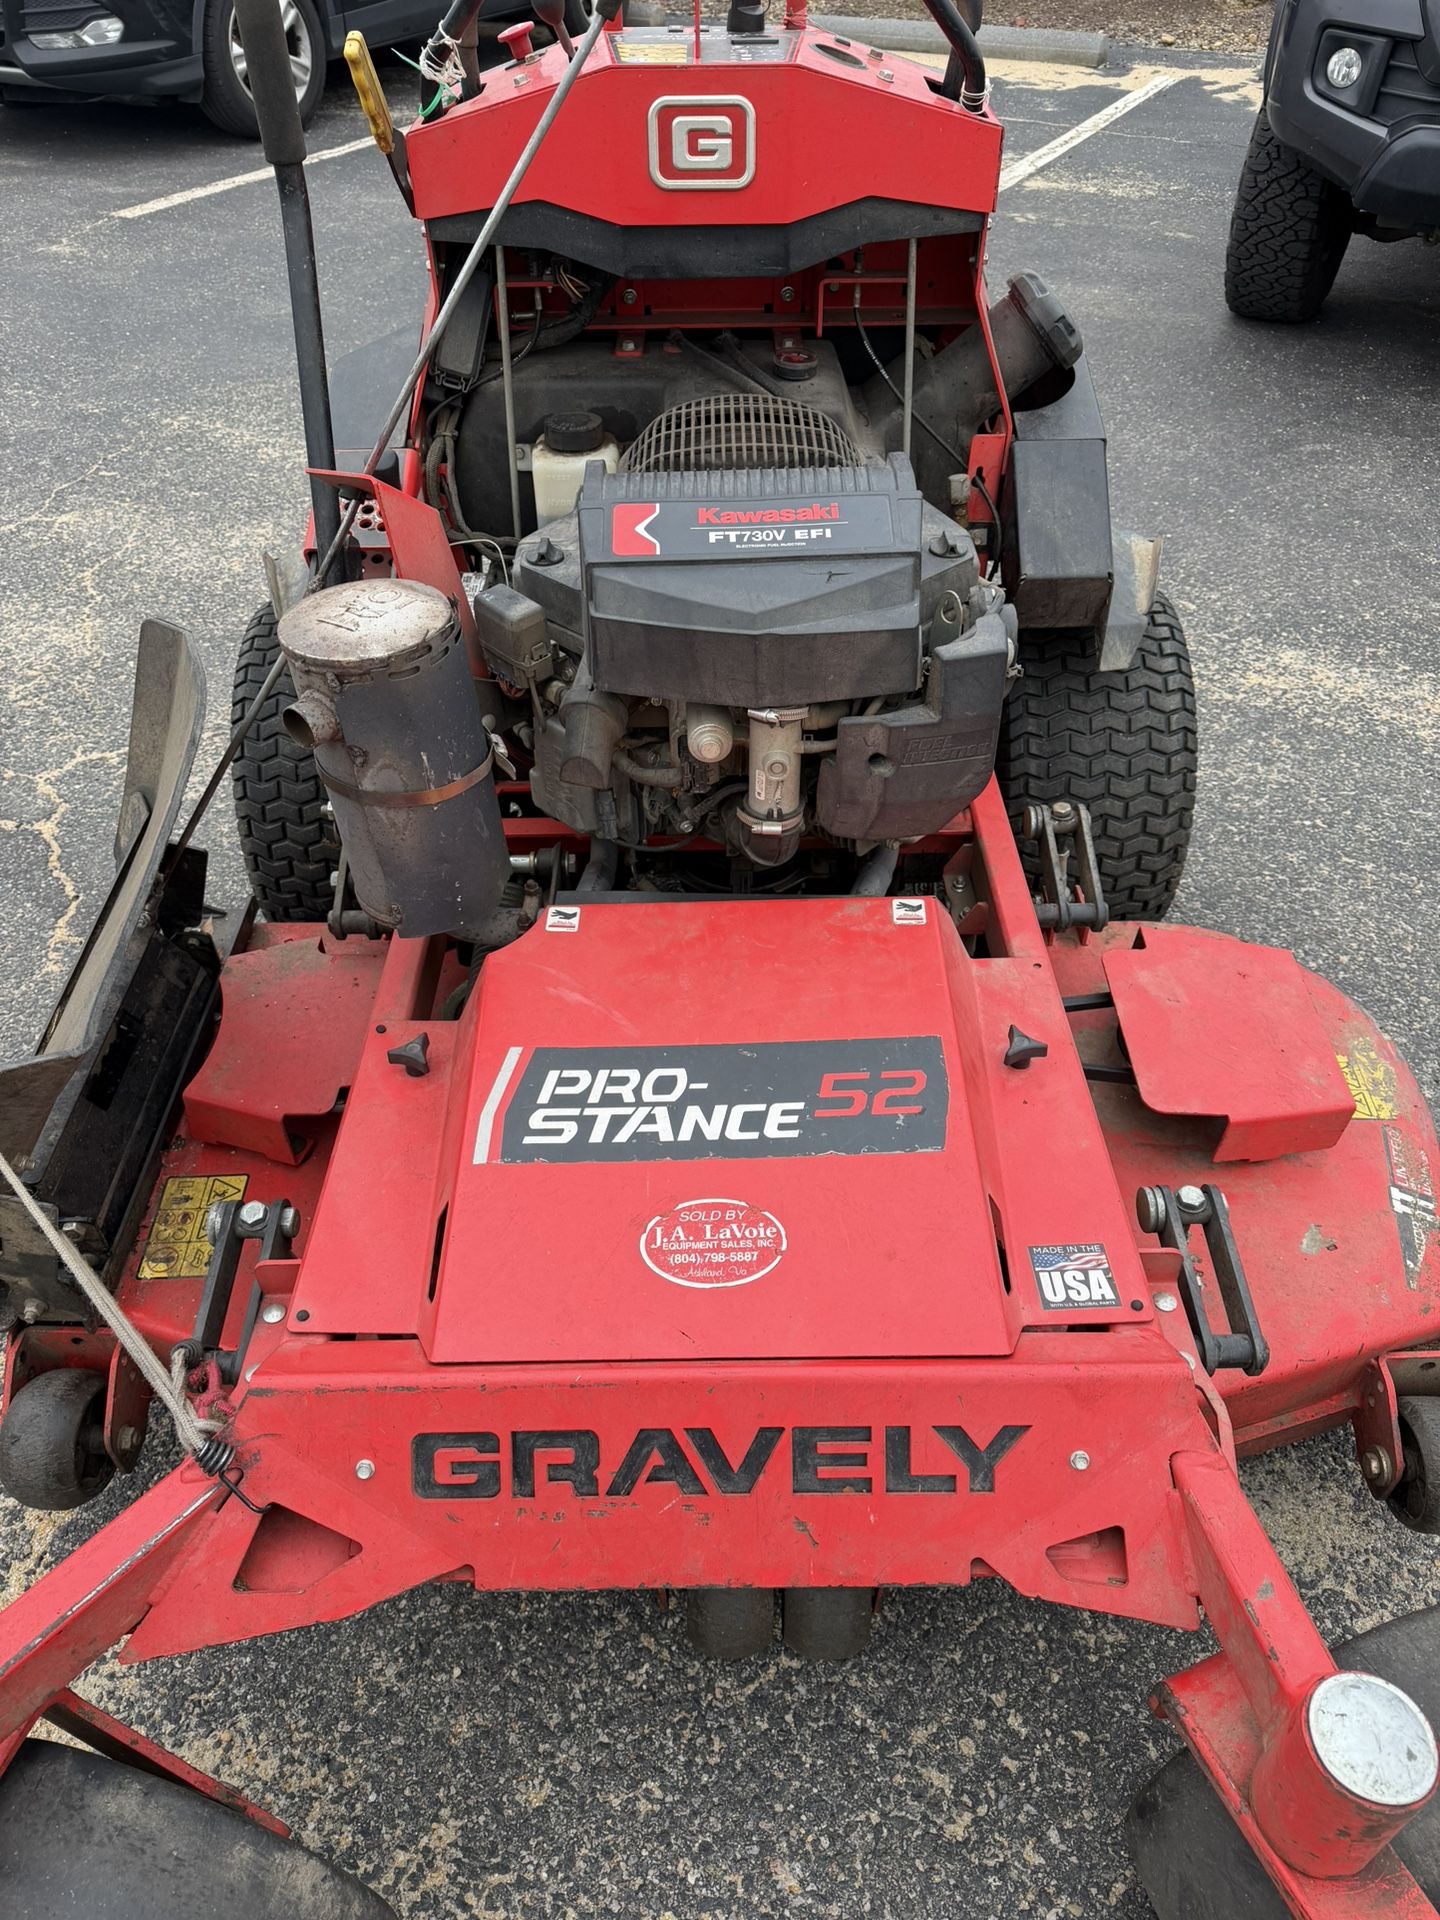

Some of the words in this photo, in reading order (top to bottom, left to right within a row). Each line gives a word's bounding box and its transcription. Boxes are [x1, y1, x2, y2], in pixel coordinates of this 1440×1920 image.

[671, 115, 733, 171] G
[697, 502, 841, 524] Kawasaki
[708, 529, 786, 543] FT730V
[794, 528, 832, 539] EFI
[536, 1067, 709, 1104] PRO-
[813, 1068, 927, 1118] 52
[521, 1101, 806, 1145] STANCE
[678, 1210, 722, 1222] SOLD
[725, 1209, 748, 1221] BY
[650, 1225, 695, 1249] J.A.
[703, 1222, 778, 1240] LaVoie
[662, 1239, 719, 1250] EQUIPMENT
[757, 1238, 777, 1248] INC.
[1032, 1246, 1064, 1254] MADE
[1079, 1244, 1102, 1252] THE
[1038, 1269, 1117, 1303] USA
[410, 1424, 1035, 1499] GRAVELY
